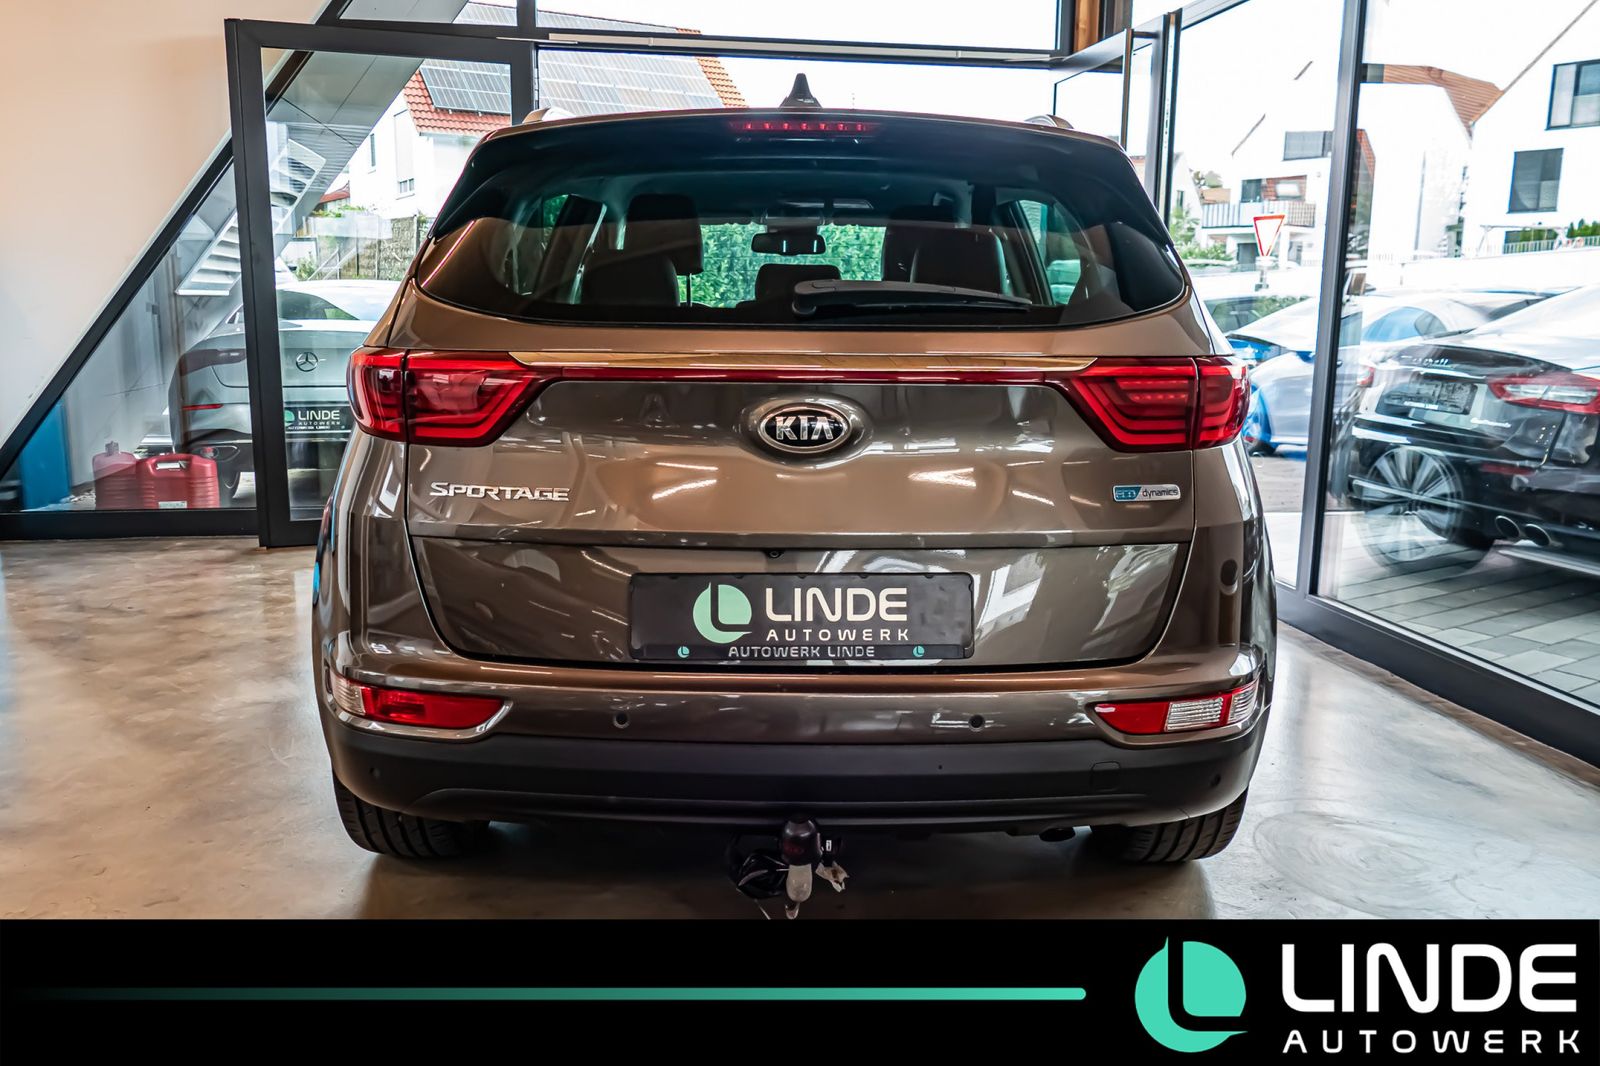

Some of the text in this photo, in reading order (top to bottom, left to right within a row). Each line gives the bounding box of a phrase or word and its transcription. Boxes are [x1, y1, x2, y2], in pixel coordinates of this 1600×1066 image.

[298, 410, 340, 420] LINDE
[775, 416, 834, 440] KIA
[429, 482, 570, 501] SPORTAGE
[1142, 488, 1179, 498] dynamics
[765, 587, 908, 622] LINDE
[766, 629, 909, 641] AUTOWERK
[728, 646, 875, 658] AUTOWERK LINDE
